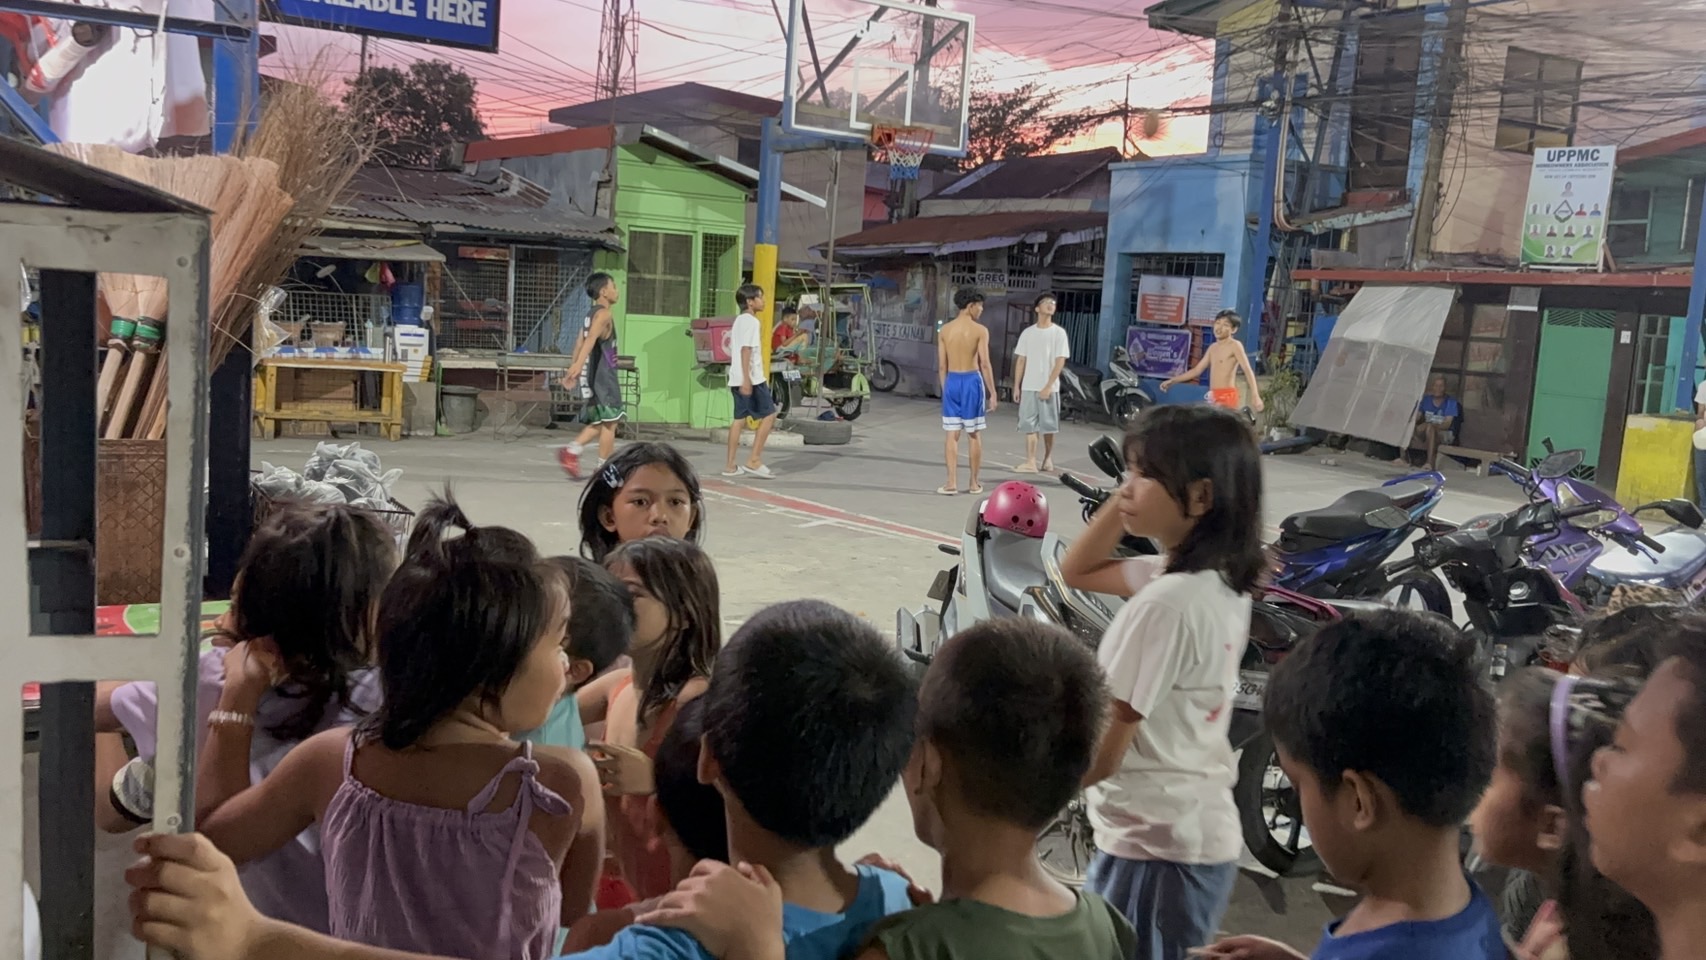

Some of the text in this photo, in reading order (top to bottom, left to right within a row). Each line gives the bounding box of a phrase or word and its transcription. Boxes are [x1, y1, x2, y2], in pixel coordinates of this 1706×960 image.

[426, 0, 487, 28] HERE
[1547, 148, 1600, 162] UPPMC
[978, 273, 1005, 282] GREG
